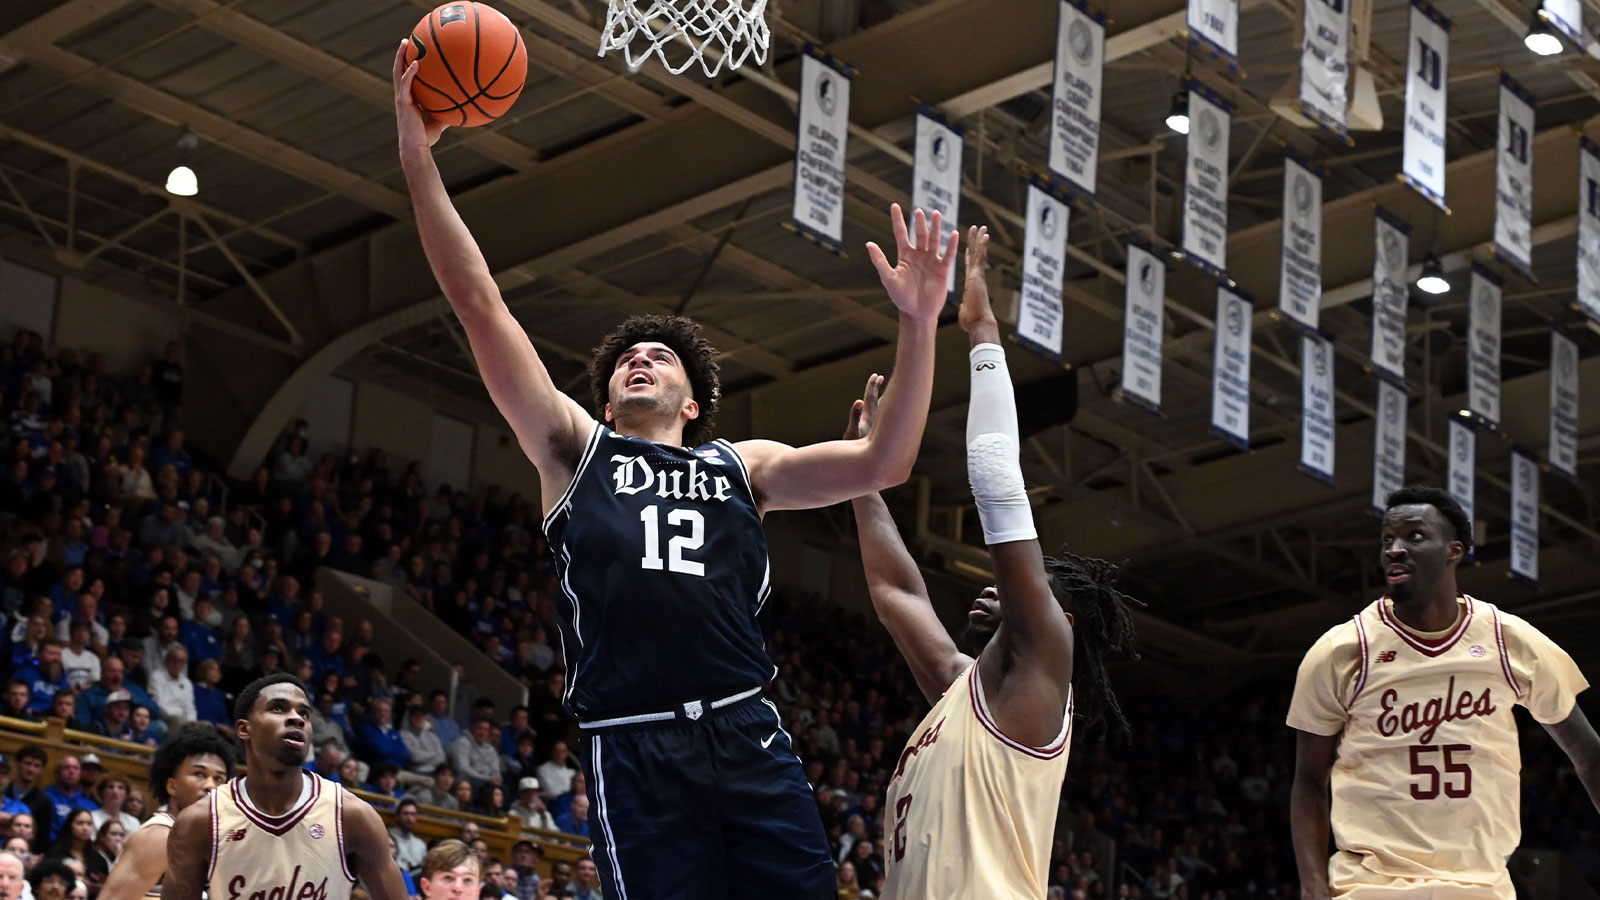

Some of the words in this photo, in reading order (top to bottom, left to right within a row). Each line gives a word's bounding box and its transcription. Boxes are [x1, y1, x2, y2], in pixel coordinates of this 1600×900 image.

[610, 454, 732, 502] Duke
[640, 505, 705, 577] 12
[1377, 675, 1497, 745] Eagles
[1409, 744, 1472, 800] 55
[228, 865, 329, 900] Eagles
